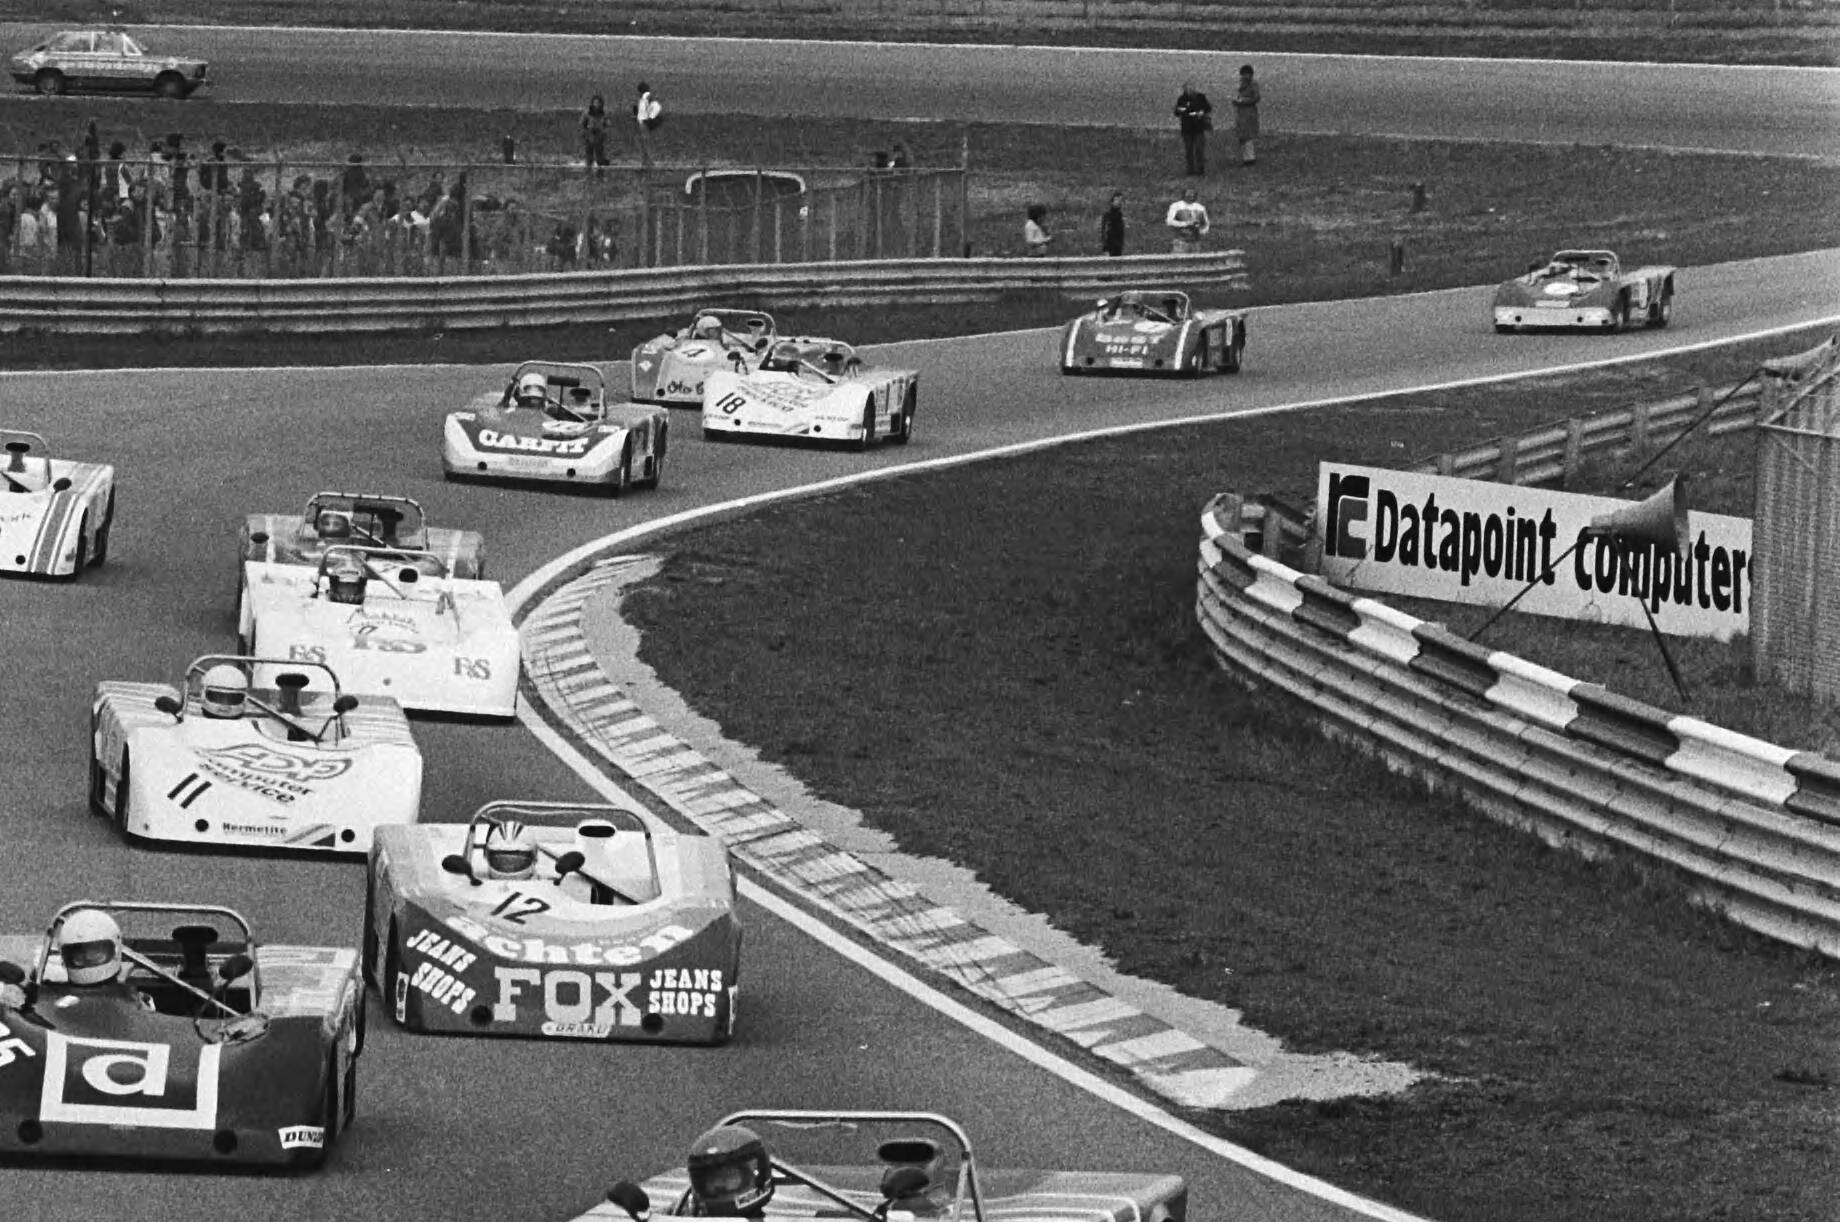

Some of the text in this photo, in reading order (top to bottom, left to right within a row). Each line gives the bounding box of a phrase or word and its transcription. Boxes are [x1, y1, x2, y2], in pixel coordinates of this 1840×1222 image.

[715, 392, 747, 415] 18
[1374, 488, 1557, 587] Datapoint
[167, 772, 213, 809] 11
[490, 891, 551, 925] 12
[406, 928, 478, 973] JEANS
[410, 961, 477, 1015] SHOPS
[493, 966, 642, 1027] FOX
[649, 967, 723, 992] JEANS
[648, 990, 717, 1017] SHOPS
